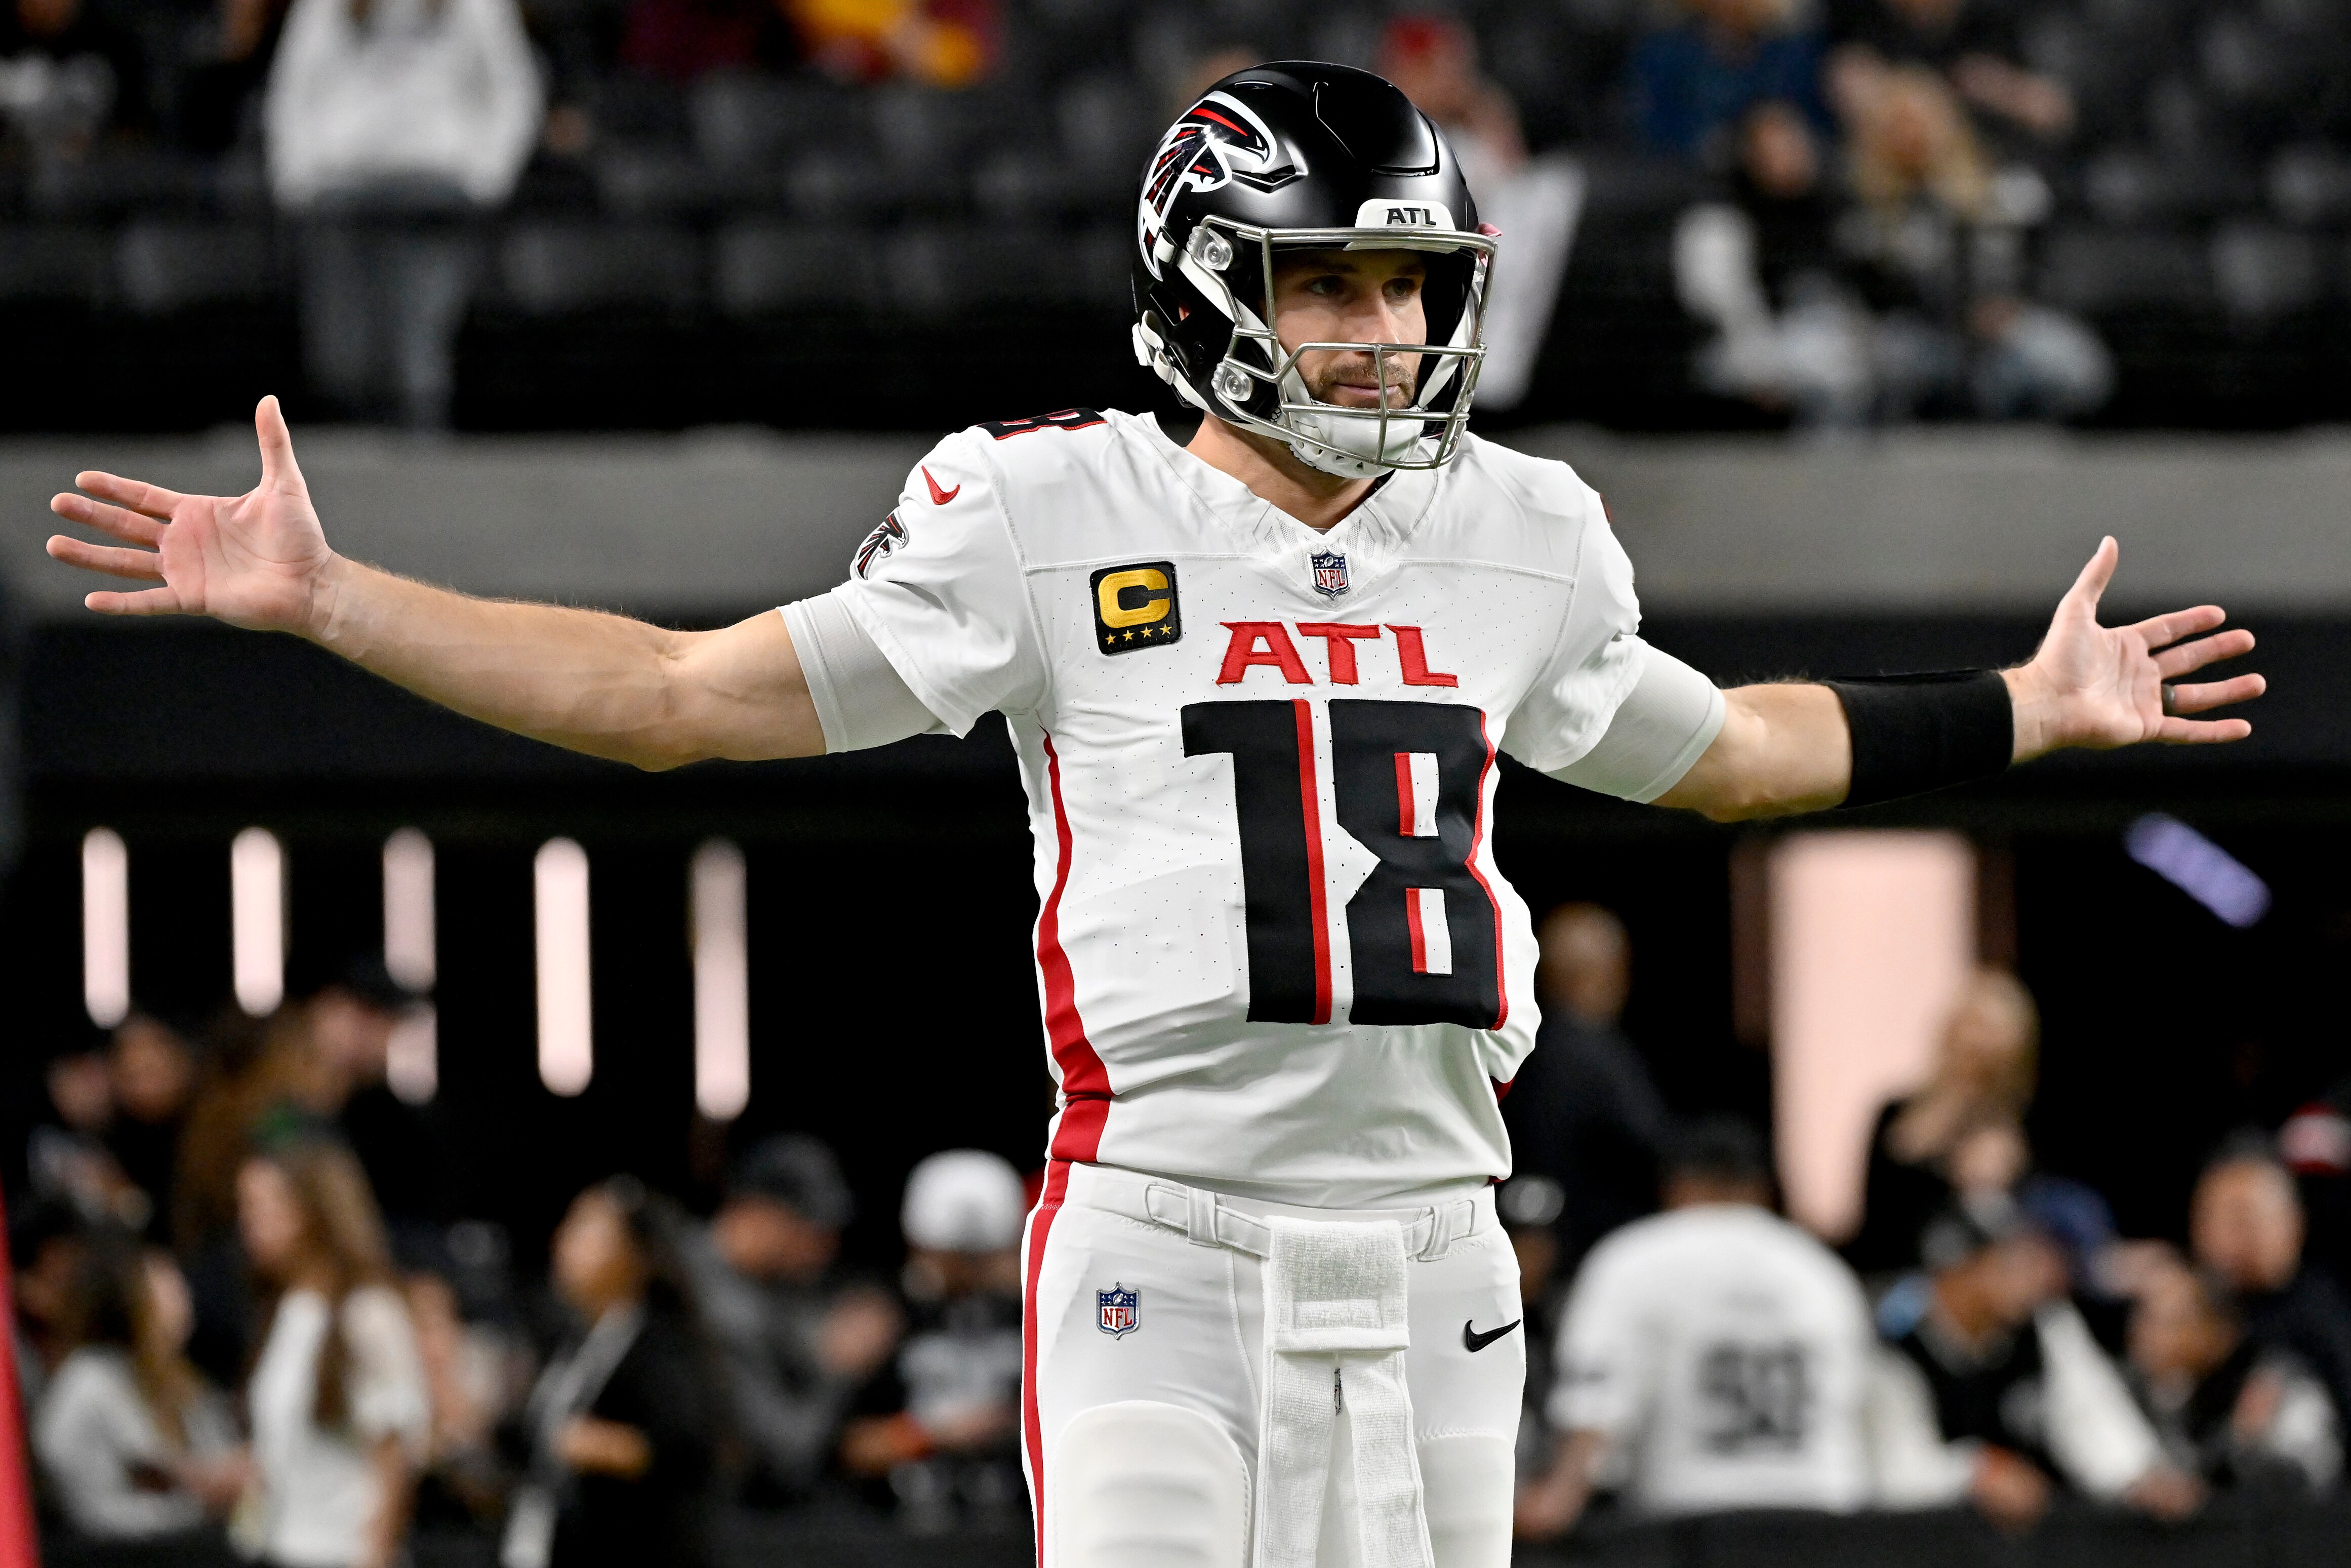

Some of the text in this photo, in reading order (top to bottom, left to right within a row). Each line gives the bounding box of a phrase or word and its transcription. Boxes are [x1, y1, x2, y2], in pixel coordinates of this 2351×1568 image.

[1387, 208, 1436, 226] ATL
[1098, 569, 1171, 628] C
[1317, 570, 1345, 589] NFL
[1215, 622, 1458, 688] ATL
[1181, 699, 1509, 1031] 18
[1103, 1308, 1132, 1329] NFL
